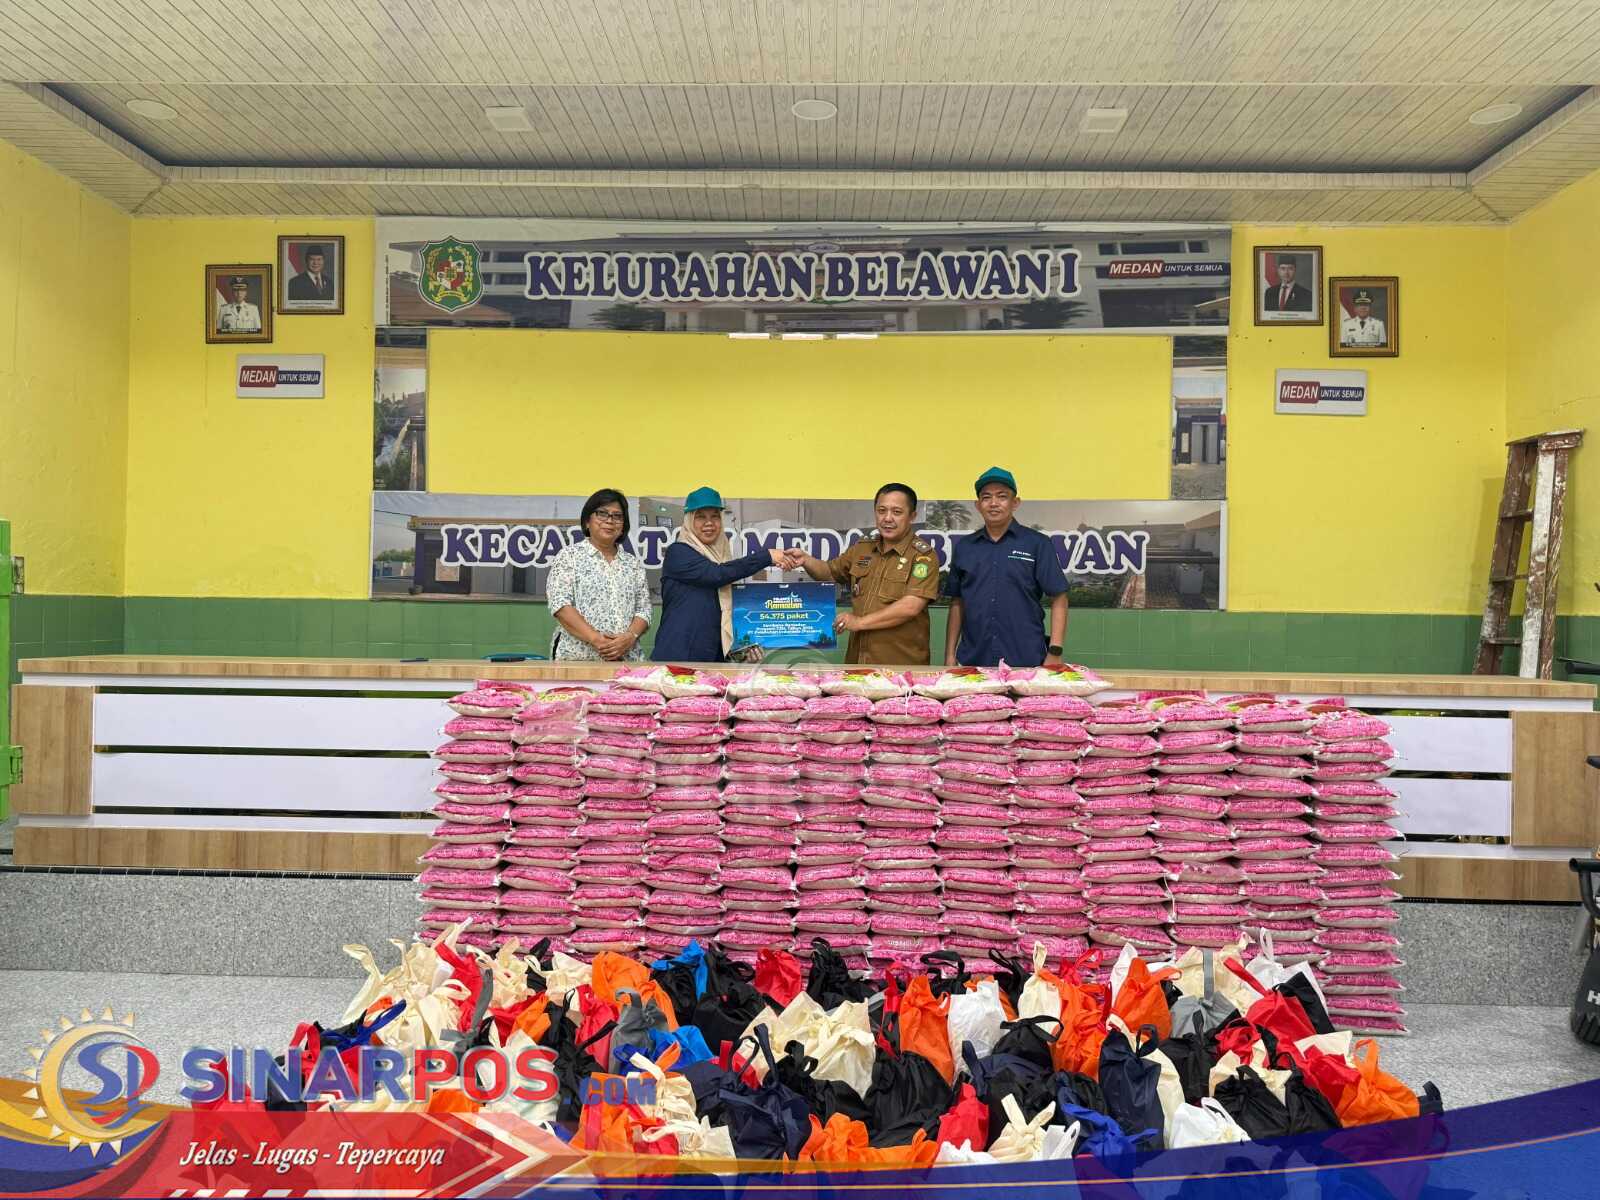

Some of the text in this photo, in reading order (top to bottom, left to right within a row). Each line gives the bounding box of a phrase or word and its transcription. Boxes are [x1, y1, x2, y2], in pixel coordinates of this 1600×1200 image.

[526, 251, 1078, 299] KELURAHAN BELAWAN I
[1109, 263, 1162, 274] MEDAN
[1194, 264, 1223, 272] SEMUA
[241, 370, 276, 383] MEDAN
[278, 374, 298, 382] UNTUK
[1281, 386, 1364, 399] MEDAN UNTUK SEMUA
[786, 612, 809, 620] paket
